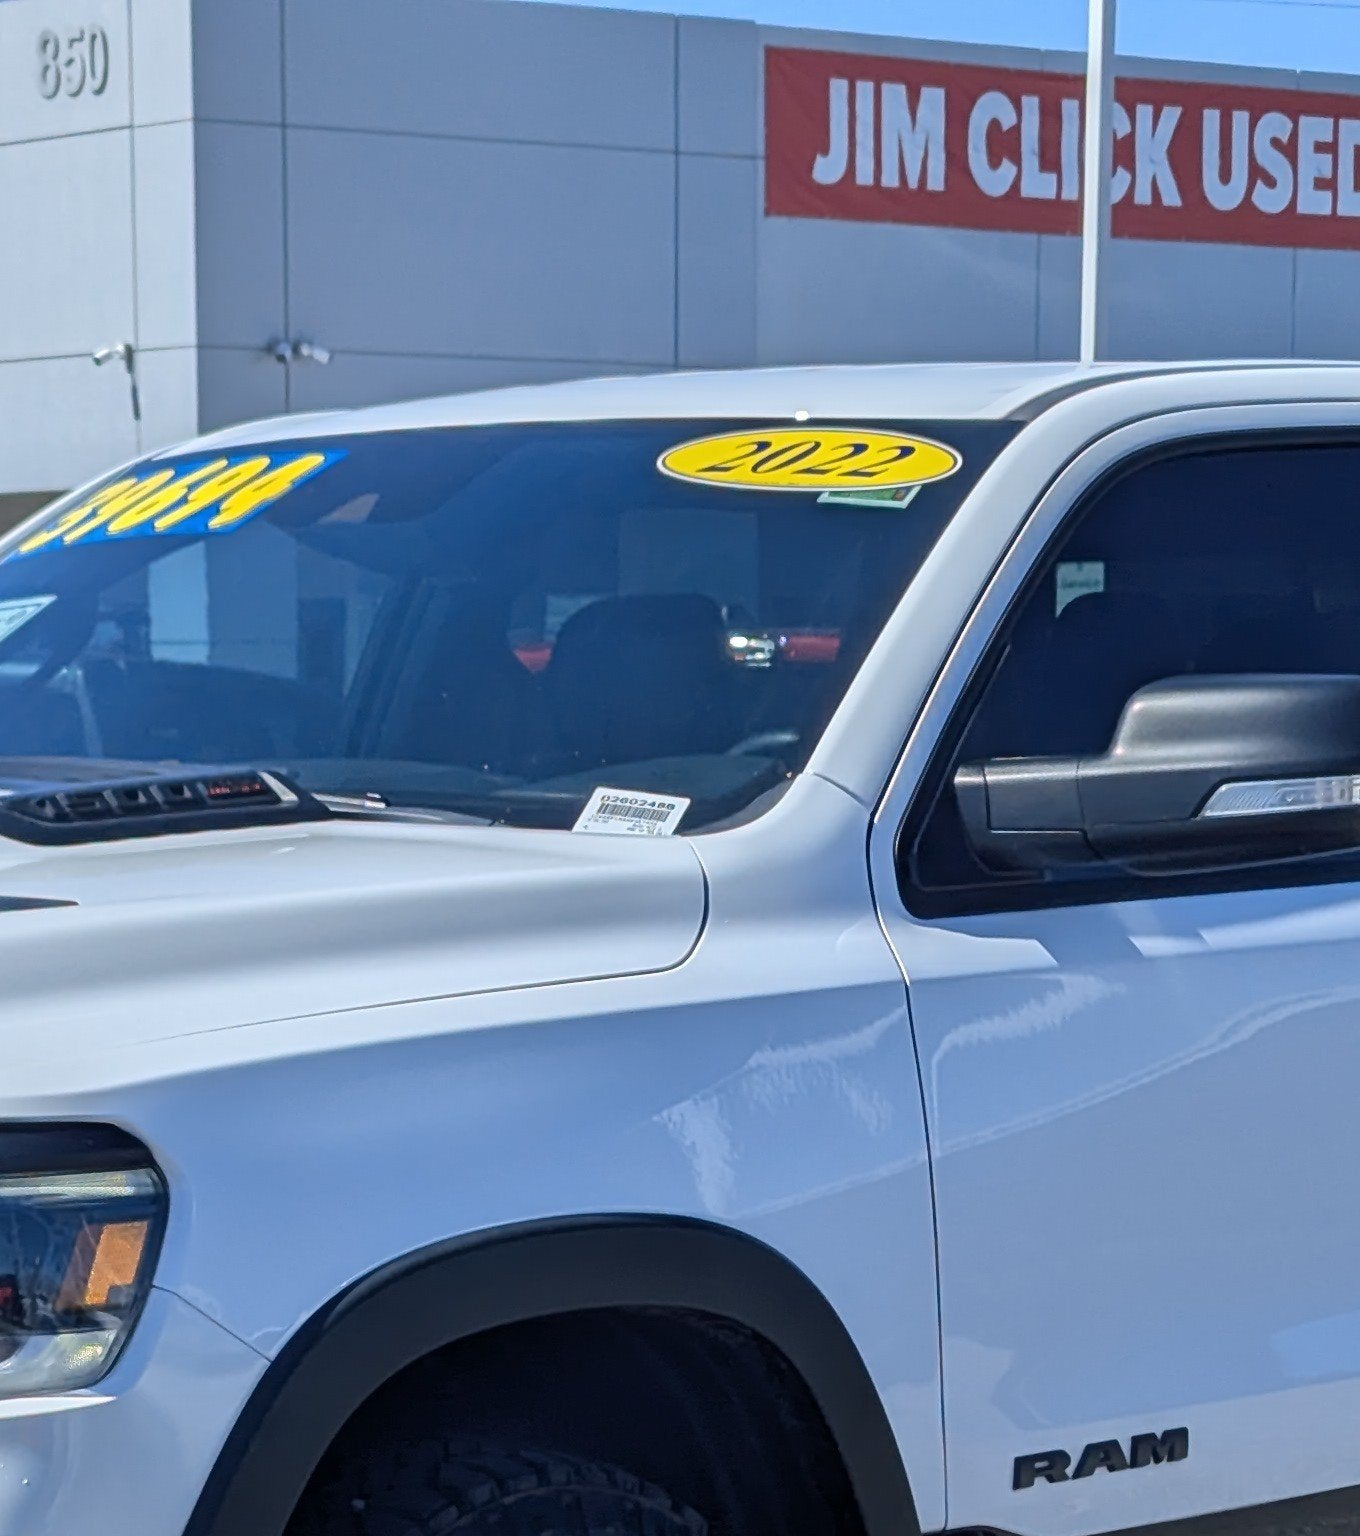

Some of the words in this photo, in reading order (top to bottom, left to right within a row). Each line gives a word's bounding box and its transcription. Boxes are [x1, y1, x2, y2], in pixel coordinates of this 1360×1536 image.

[37, 25, 109, 99] 850
[812, 77, 946, 191] JIM
[696, 440, 916, 478] 2022
[1012, 1427, 1189, 1490] RAM
